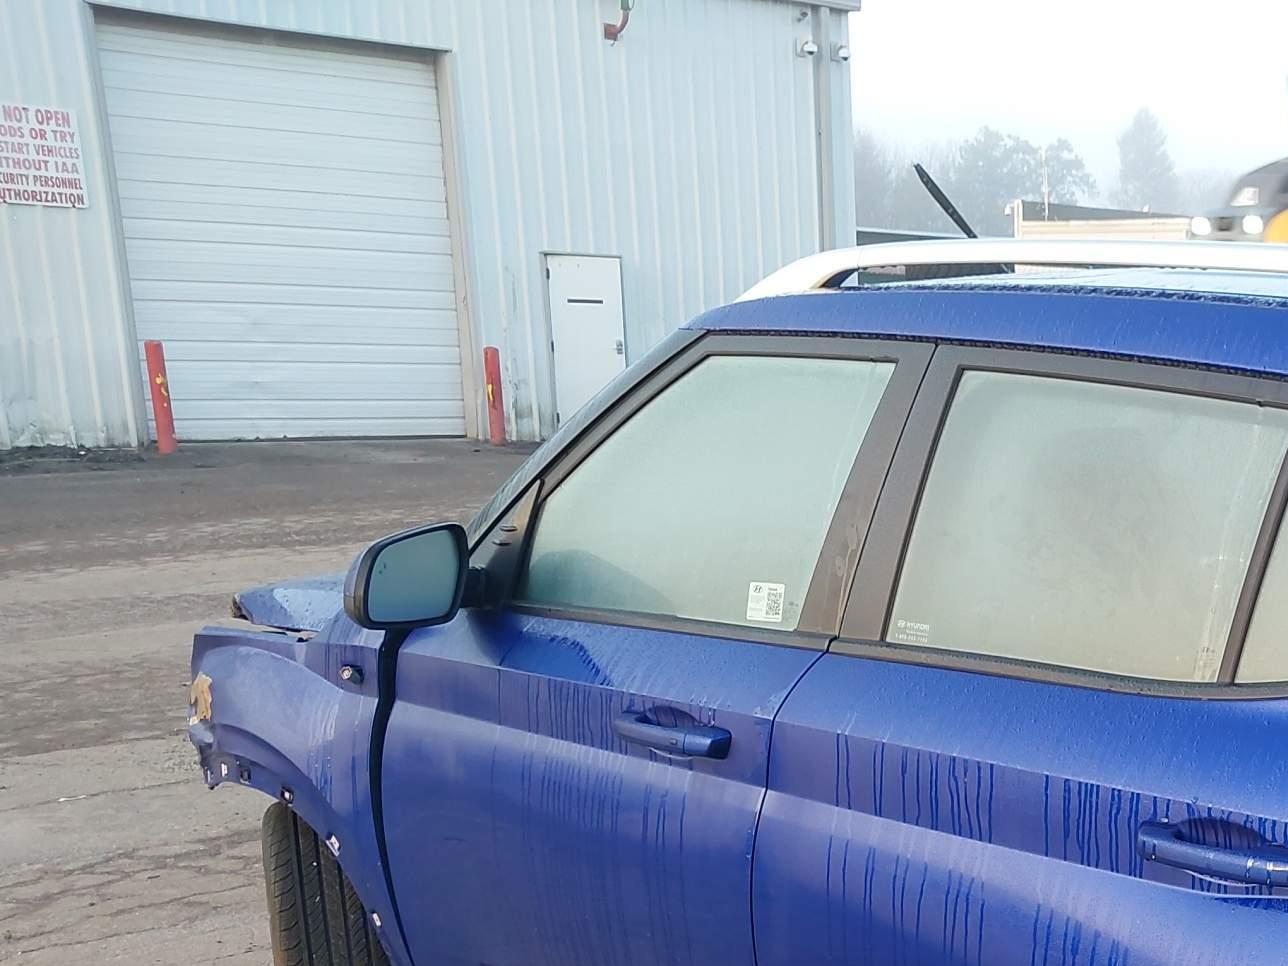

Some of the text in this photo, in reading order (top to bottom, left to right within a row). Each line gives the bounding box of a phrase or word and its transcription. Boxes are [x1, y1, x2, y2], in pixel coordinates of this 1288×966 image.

[2, 104, 71, 129] NOT OPEN
[29, 127, 48, 141] OR
[51, 129, 75, 144] TRY
[33, 143, 80, 160] VEHICLES
[54, 160, 80, 175] IAA
[33, 174, 83, 190] PERSONNEL
